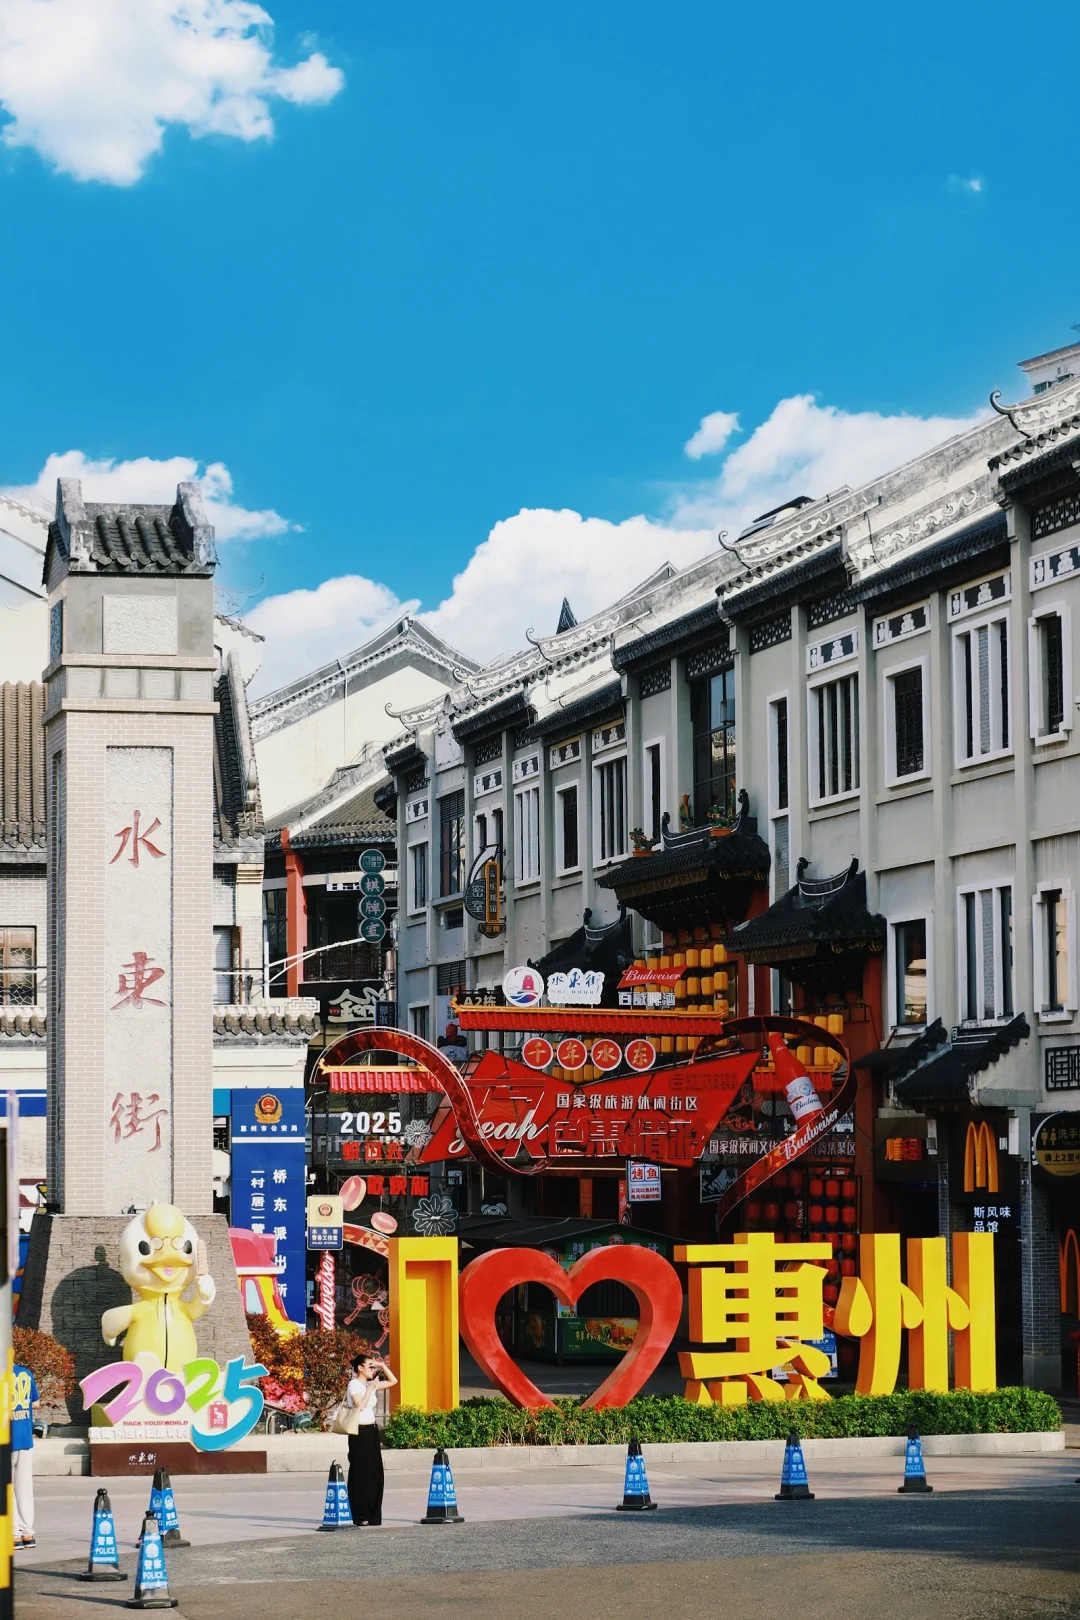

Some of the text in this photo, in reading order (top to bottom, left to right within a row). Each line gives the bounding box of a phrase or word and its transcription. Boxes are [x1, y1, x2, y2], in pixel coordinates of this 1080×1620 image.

[365, 877, 381, 938] 棋牌室
[621, 968, 682, 981] Budweiser
[618, 991, 676, 1007] 百威啤酒
[529, 1043, 649, 1066] 千年水东
[557, 1093, 698, 1110] 国家级旅游休闲街区
[240, 1124, 298, 1133] 惠州市公安局
[340, 1111, 402, 1134] 2025
[778, 1108, 840, 1160] Budweiser
[1058, 1127, 1080, 1139] 洗手
[709, 1139, 856, 1156] 国家级夜间文化消费集聚区
[973, 1206, 1011, 1218] 斯风味
[273, 1168, 287, 1298] 桥东派出所
[672, 1232, 997, 1408] 惠州
[79, 1354, 270, 1452] 2025
[95, 1547, 116, 1555] POLICE
[142, 1571, 164, 1580] POLICE
